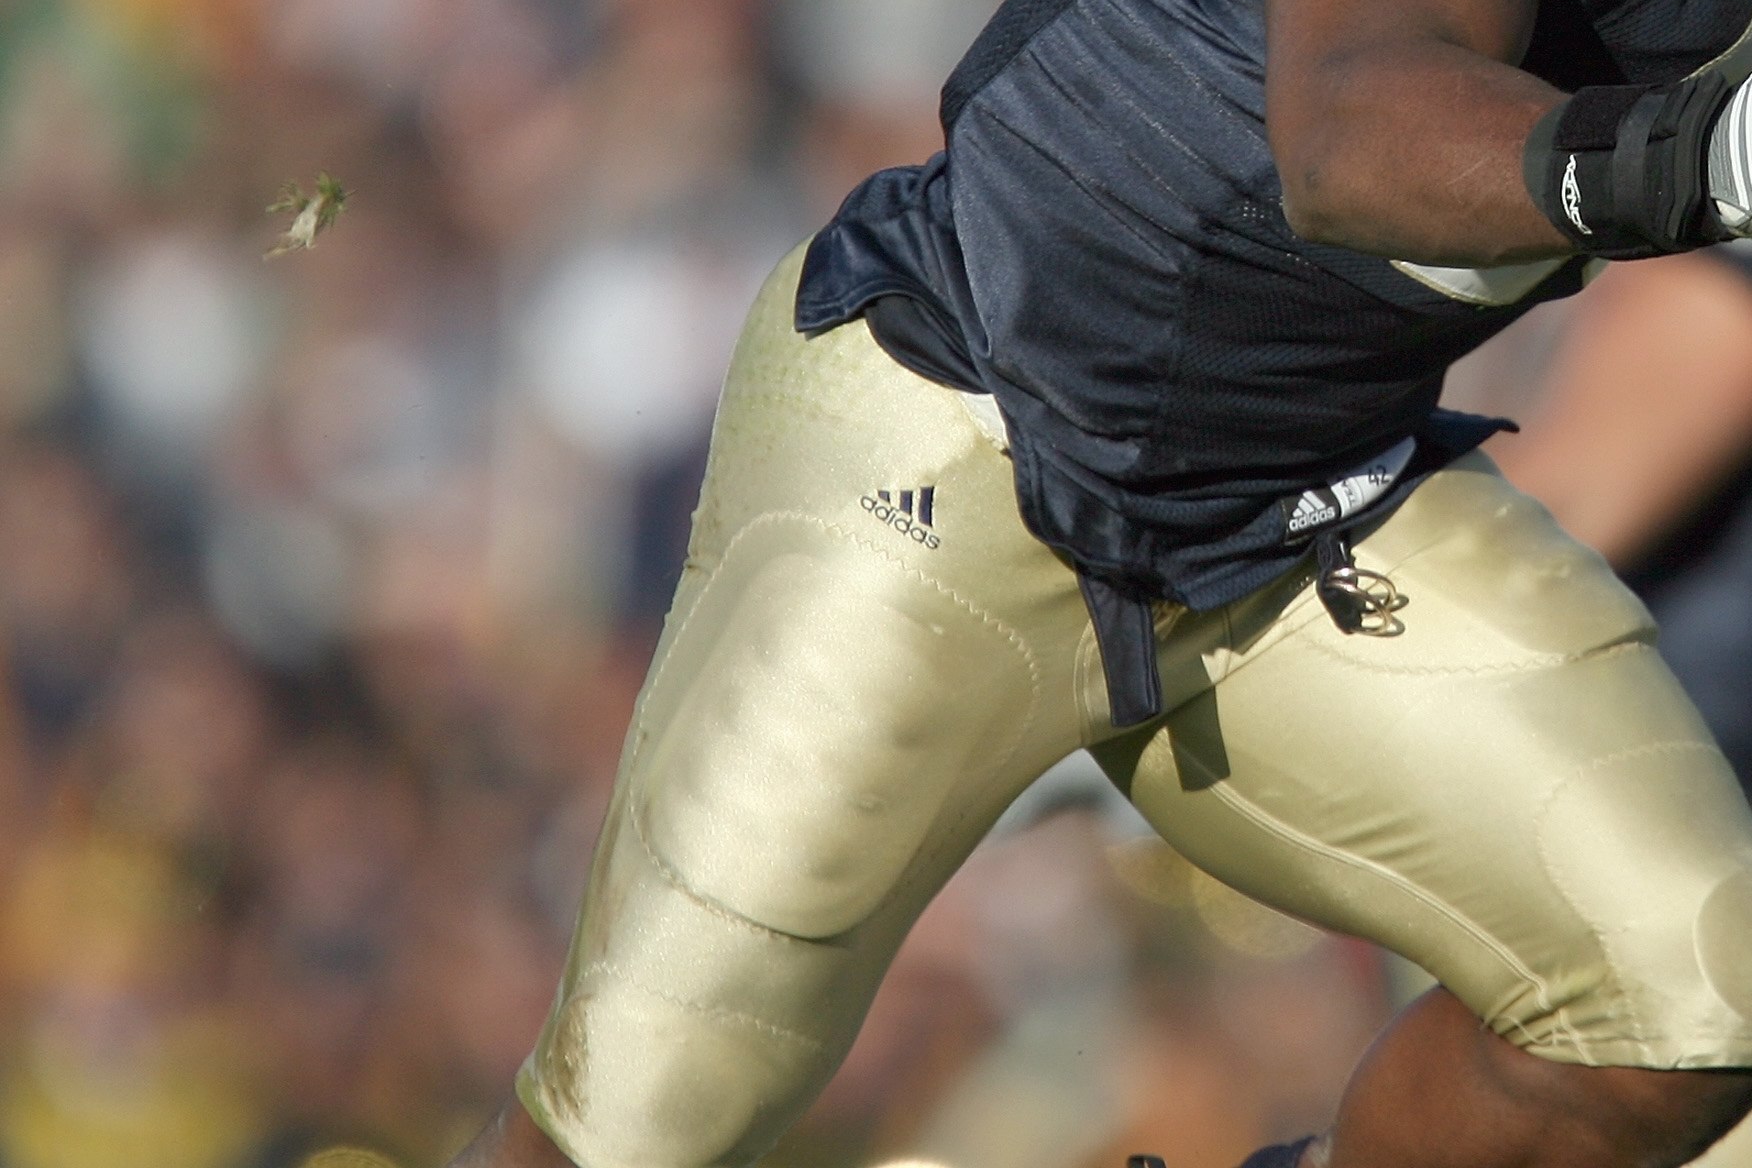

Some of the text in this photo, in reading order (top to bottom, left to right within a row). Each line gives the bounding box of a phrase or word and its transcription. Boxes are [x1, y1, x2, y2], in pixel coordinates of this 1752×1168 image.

[1368, 464, 1390, 487] 42
[860, 495, 941, 550] adidas
[1289, 505, 1336, 532] adidas
